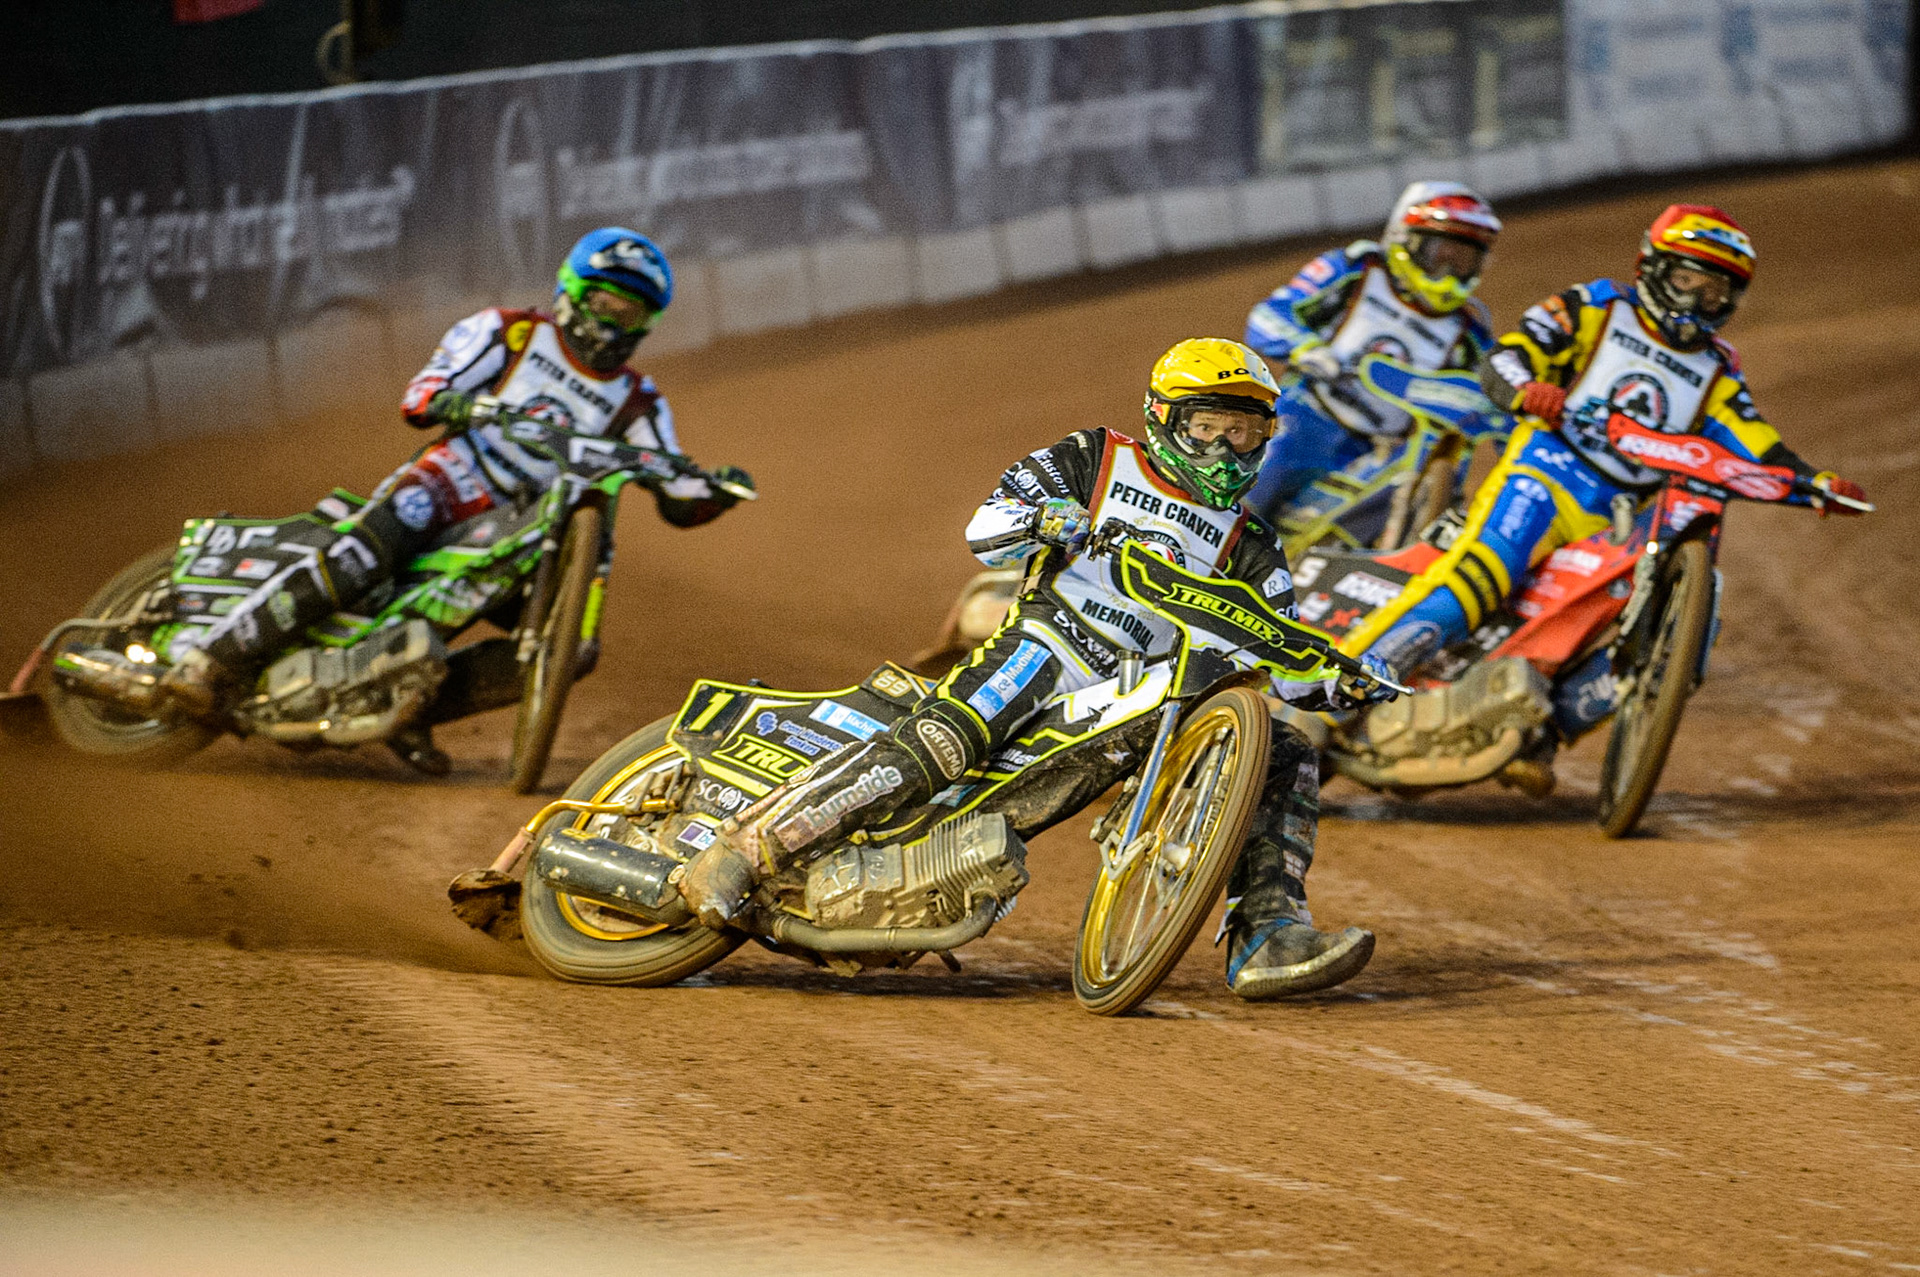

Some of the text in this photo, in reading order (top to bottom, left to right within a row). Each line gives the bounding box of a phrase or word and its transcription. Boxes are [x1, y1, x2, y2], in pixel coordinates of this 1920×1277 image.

[1109, 481, 1224, 549] PETER CRAVEN
[1081, 598, 1155, 652] MEMORIAL
[1179, 588, 1231, 615] TRU
[1230, 610, 1277, 641] MIX
[1005, 641, 1041, 681] Machine
[688, 692, 735, 732] 1
[846, 713, 877, 736] Machin
[802, 728, 844, 751] Henderso
[921, 723, 962, 776] ORTEMA
[805, 766, 902, 827] burnside
